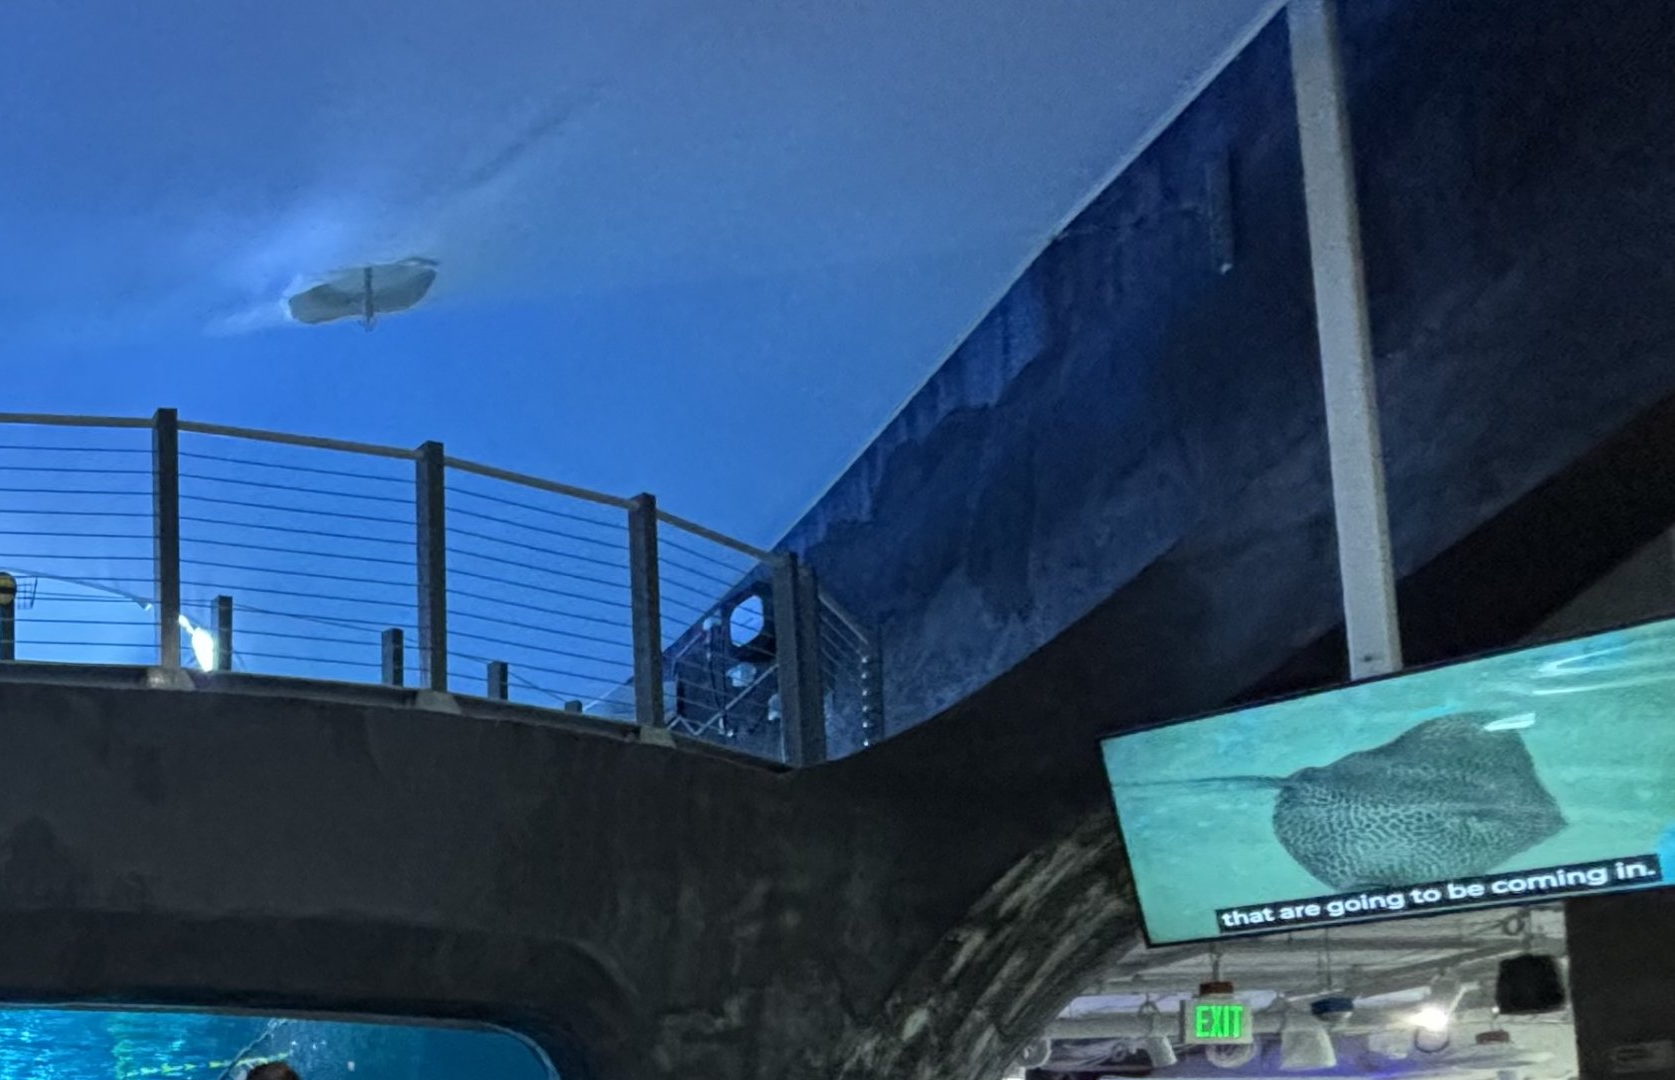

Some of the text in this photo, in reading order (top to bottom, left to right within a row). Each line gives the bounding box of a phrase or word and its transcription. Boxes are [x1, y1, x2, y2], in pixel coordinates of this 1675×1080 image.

[1221, 860, 1657, 927] that are going to be coming in.
[1194, 1003, 1244, 1039] EXIT
